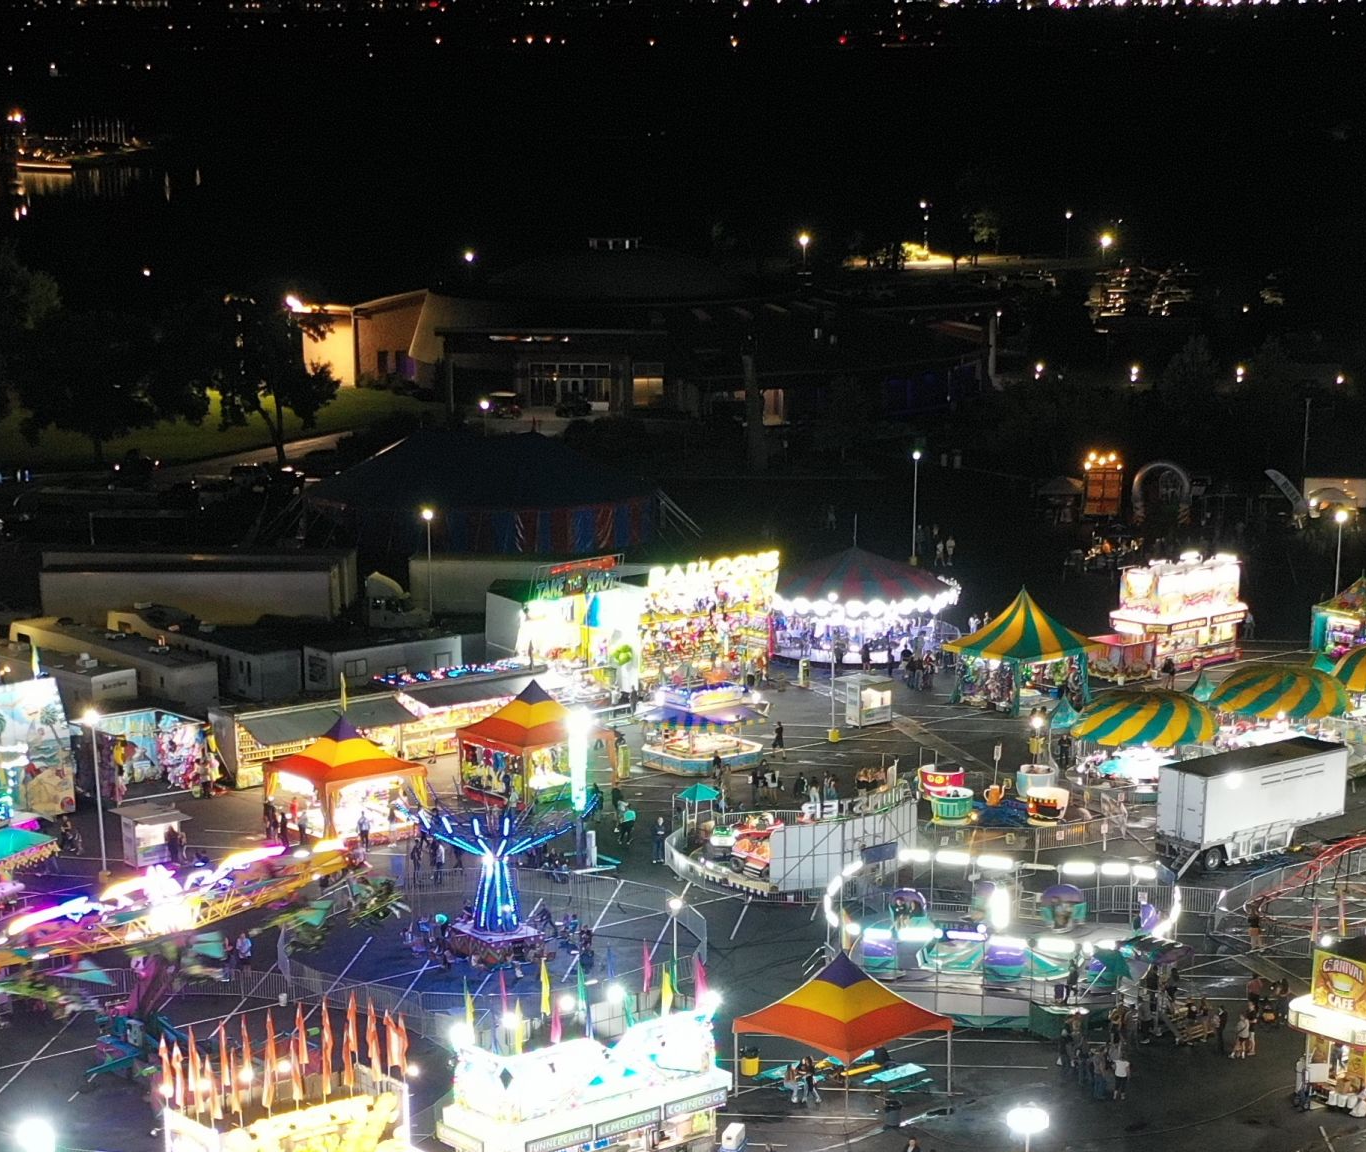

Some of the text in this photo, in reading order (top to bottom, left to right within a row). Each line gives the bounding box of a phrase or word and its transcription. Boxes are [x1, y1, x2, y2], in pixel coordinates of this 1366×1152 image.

[648, 551, 781, 588] BALLOONS
[536, 571, 619, 600] TAKE THE SHOT
[1322, 958, 1365, 984] CARNIVAL
[1327, 993, 1355, 1010] CAFE
[599, 1110, 659, 1136] LEMONADE
